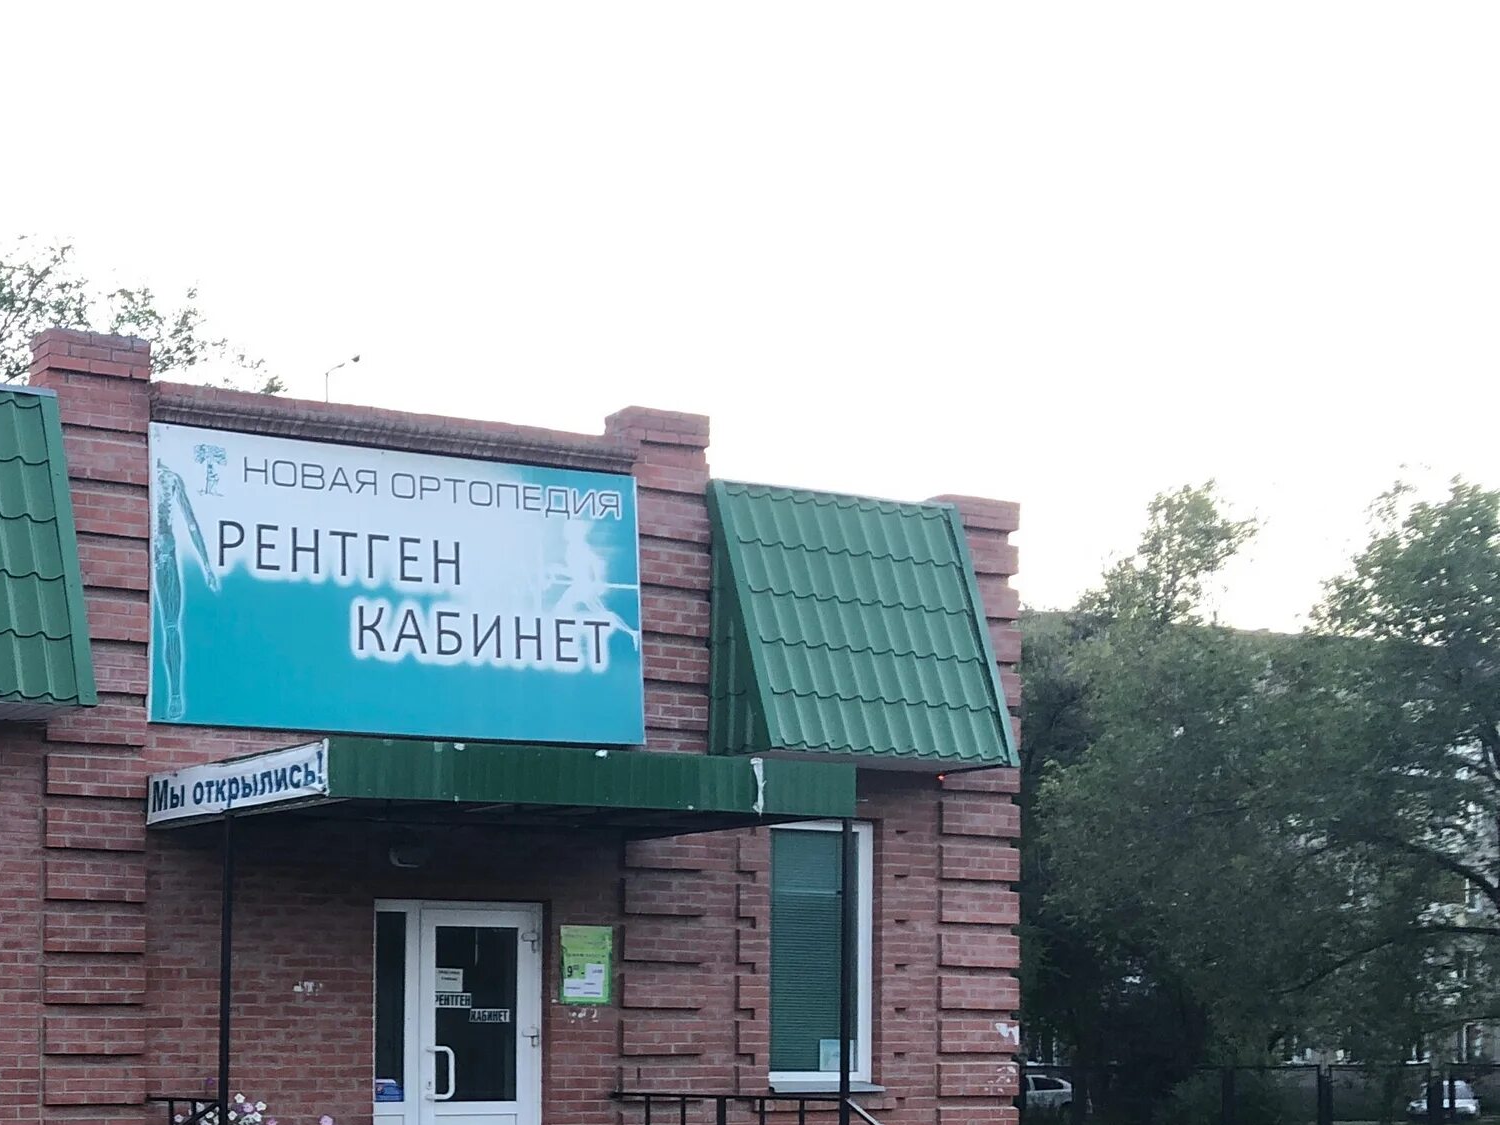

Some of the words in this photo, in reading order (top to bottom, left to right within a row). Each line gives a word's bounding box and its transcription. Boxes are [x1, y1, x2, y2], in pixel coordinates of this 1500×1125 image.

[243, 456, 378, 496] НОВАЯ
[391, 472, 621, 520] ОРТОПЕДИЯ
[217, 520, 461, 586] РЕНТГЕН
[357, 605, 610, 664] КАБИНЕТ
[152, 779, 185, 812] Мы
[193, 751, 323, 808] открылись!
[470, 1010, 508, 1022] КАБИНЕТ
